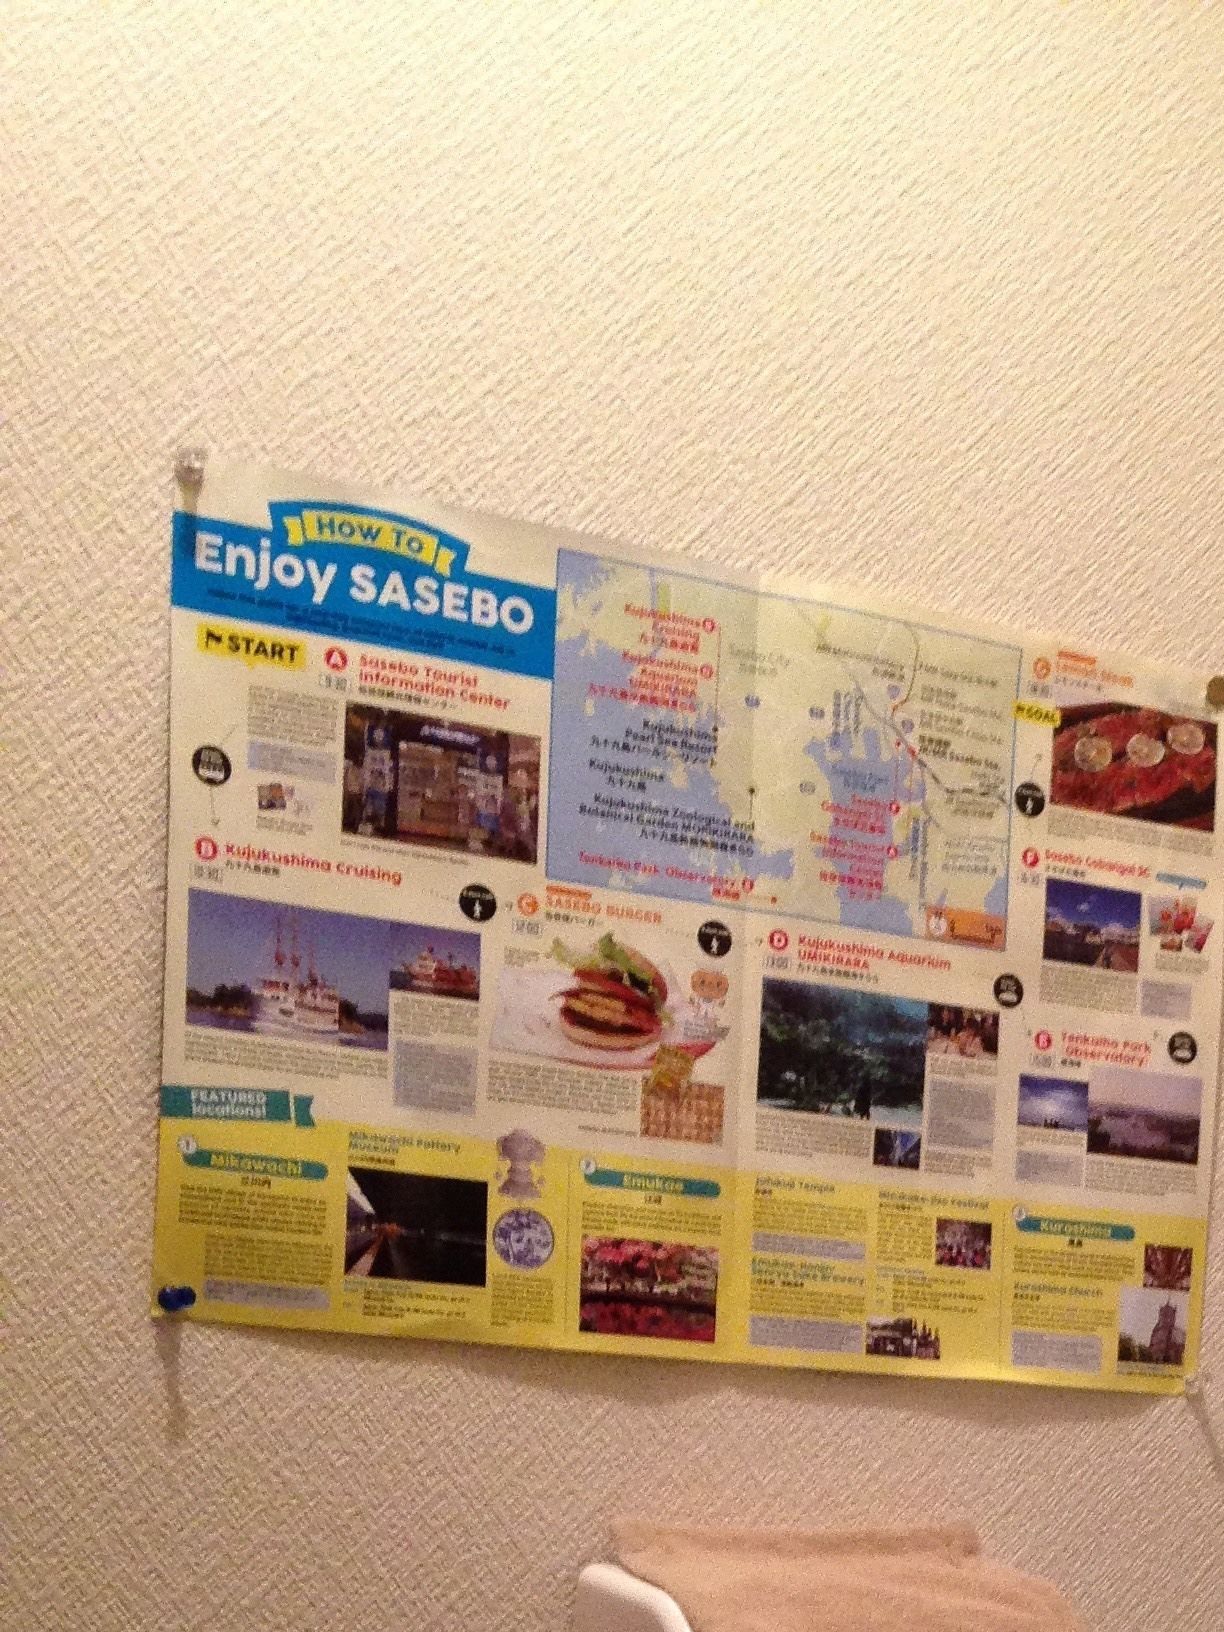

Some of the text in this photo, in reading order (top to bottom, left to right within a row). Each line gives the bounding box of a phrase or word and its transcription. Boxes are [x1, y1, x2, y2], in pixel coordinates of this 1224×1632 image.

[317, 516, 426, 555] HOW TO
[193, 531, 338, 605] Enjoy
[348, 563, 535, 635] SASEBO
[228, 638, 310, 664] START
[359, 653, 419, 676] Sasebo
[424, 664, 479, 688] Tourist
[359, 669, 455, 699] Information
[459, 688, 511, 712] Center
[224, 841, 331, 873] Kujukushima
[190, 1088, 266, 1105] FEATURED
